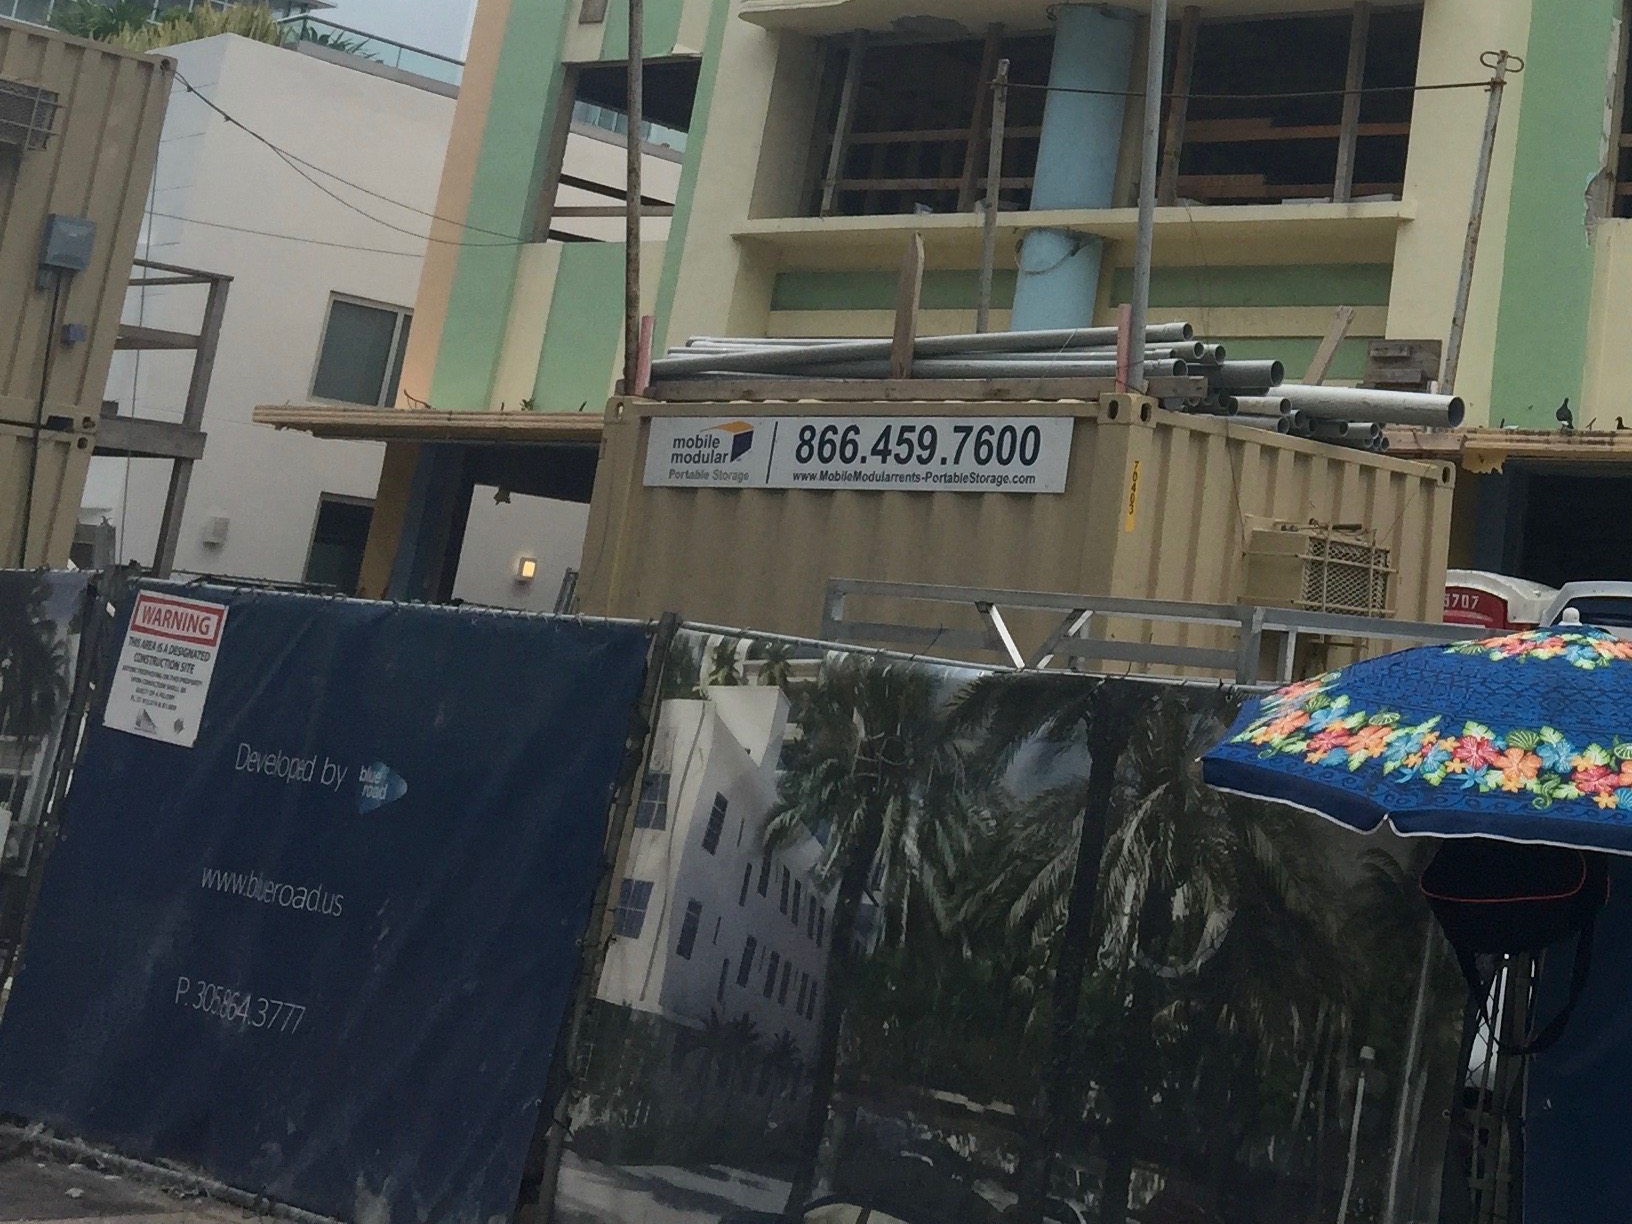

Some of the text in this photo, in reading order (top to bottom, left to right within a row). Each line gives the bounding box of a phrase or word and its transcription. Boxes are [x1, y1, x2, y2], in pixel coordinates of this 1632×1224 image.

[673, 434, 720, 450] mobile
[795, 424, 1042, 467] 866.459.7600
[670, 450, 728, 465] modular
[668, 468, 750, 484] Portable Storage
[141, 605, 212, 636] WARNING
[133, 652, 195, 675] CONSTRUCTION SITE
[235, 742, 383, 792] Developed by blue
[361, 784, 388, 800] road
